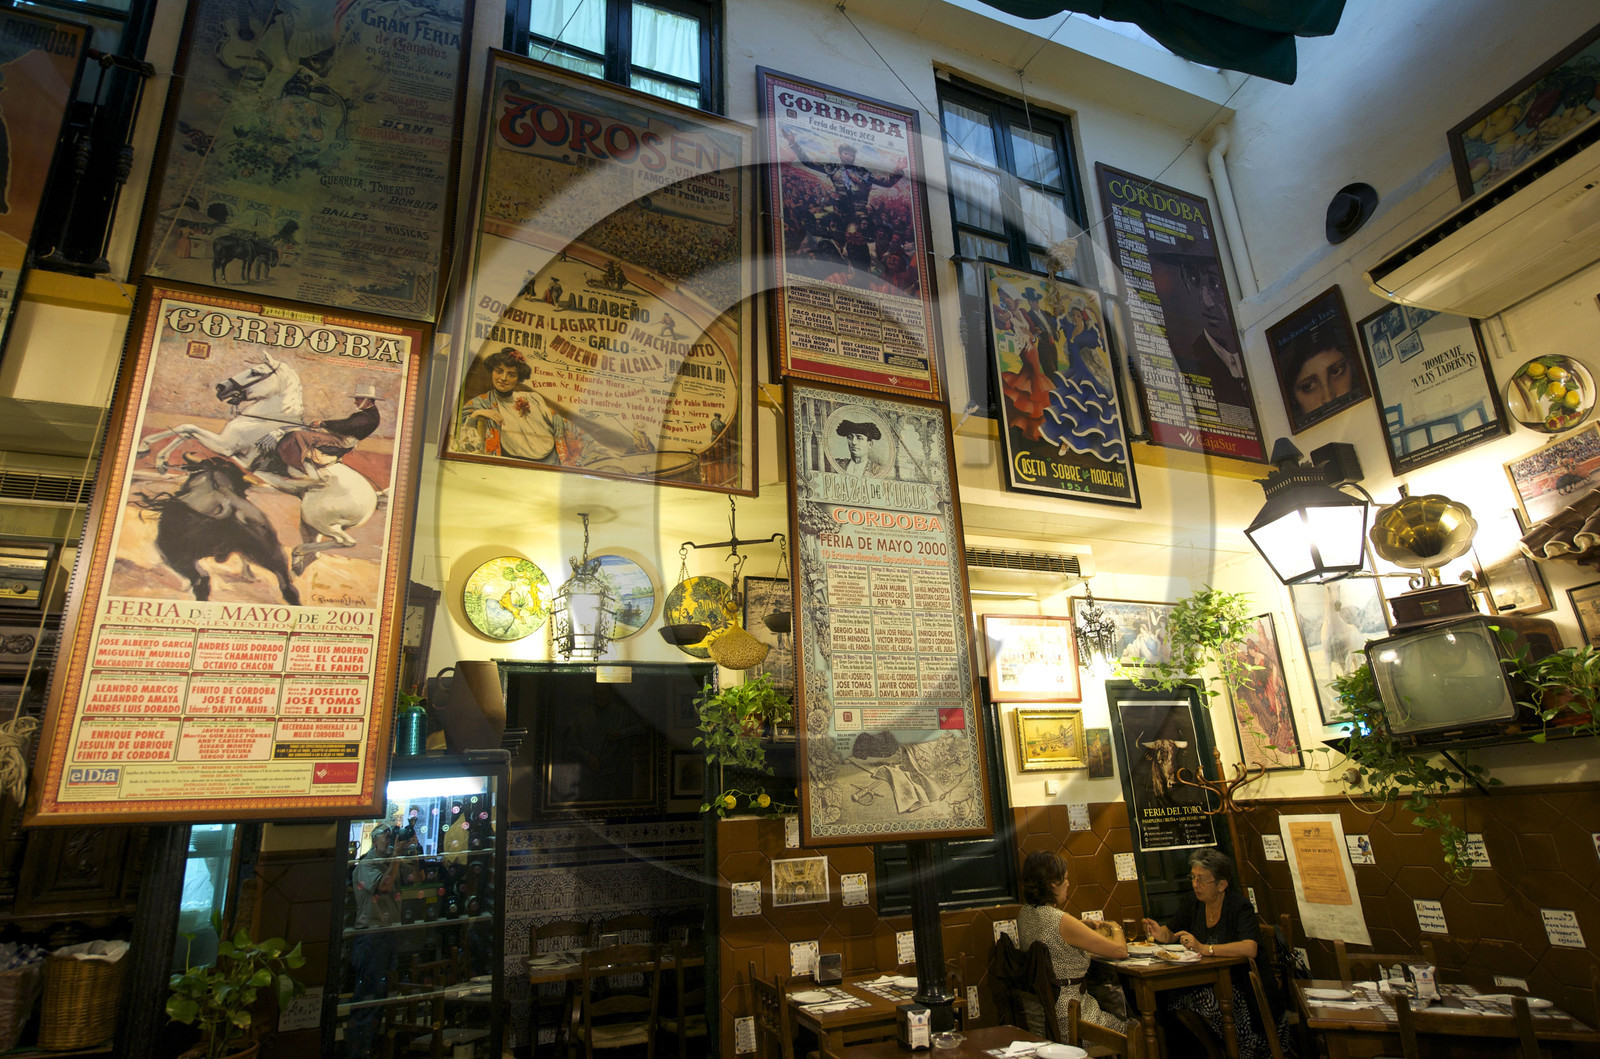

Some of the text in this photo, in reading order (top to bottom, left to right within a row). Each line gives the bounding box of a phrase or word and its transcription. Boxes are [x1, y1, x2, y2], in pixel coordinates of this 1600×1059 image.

[361, 8, 461, 51] GRAN FERIA
[778, 91, 905, 139] CORDOBA
[808, 116, 828, 130] Feria
[828, 122, 839, 131] de
[499, 94, 667, 174] TOROS
[670, 134, 721, 175] EN
[674, 166, 726, 190] VALENCIA
[369, 180, 416, 197] TORERITO
[638, 170, 731, 202] FAMOSAS CORRIDAS
[663, 187, 676, 196] DE
[388, 196, 439, 211] BOMBITA
[1108, 179, 1207, 225] CÓRDOBA
[320, 207, 369, 221] BAILES
[384, 225, 430, 240] MUSICAS
[568, 292, 650, 323] ALGABEÑO
[811, 311, 832, 320] OJEDA
[478, 294, 715, 358] BOMBITA LAGARTIJO MACHAQUITO
[165, 307, 403, 364] CORDOBA
[475, 322, 630, 354] REGATERIN GALLO
[791, 340, 836, 353] REYES MENDOZA
[549, 334, 663, 374] MORENO DE ALCALA
[1421, 344, 1466, 371] HOMENAJE
[668, 359, 713, 381] BOMBITA
[1411, 378, 1420, 389] A
[1418, 370, 1436, 386] LAS
[1434, 351, 1477, 377] TABERNAS
[575, 374, 626, 389] Eduardo Miura
[683, 398, 726, 409] Pablo Romero
[688, 410, 710, 419] Sierra
[685, 422, 707, 433] Varela
[1196, 434, 1237, 452] CajaSur
[1014, 451, 1047, 482] CASETA
[823, 474, 929, 511] PLAZA DE TOROS
[1061, 482, 1091, 493] 1954
[832, 507, 945, 533] CORDOBA
[820, 533, 947, 556] FERIA DE MAYO 2000
[105, 600, 374, 626] FERIA MAYO DE 2001
[233, 621, 295, 630] FESTEJOS
[854, 627, 869, 635] SANZ
[847, 635, 871, 643] MENDOZA
[918, 629, 938, 638] ENRIQUE
[99, 638, 120, 646] JOSE
[122, 639, 160, 648] ALBERTO
[231, 643, 284, 652] LUIS DORADO
[149, 650, 190, 659] MURILLO
[290, 645, 369, 655] JOSE LUIS MORENO
[224, 652, 278, 661] CHAMANIETO
[316, 655, 364, 664] EL CALIFA
[95, 659, 154, 668] MACHAQUITO DE
[202, 661, 239, 669] OCTAVIO
[314, 664, 364, 672] EL FANDI
[96, 684, 178, 694] LEANDRO MARCOS
[191, 686, 234, 694] FINITO DE
[836, 681, 850, 689] JOSE
[879, 682, 918, 690] JAVIER CONDE
[308, 688, 360, 696] JOSELITO
[91, 694, 179, 704] ALEJANDRO AMAYA
[201, 696, 227, 704] JOSE
[285, 697, 315, 705] JOSE
[123, 704, 181, 713] LUIS DORADO
[304, 706, 355, 714] EL JULI
[91, 730, 165, 740] ENRIQUE PONCE
[118, 740, 131, 749] DE
[132, 740, 174, 749] UBRIQUE
[76, 751, 124, 760] FINITO DE
[1143, 805, 1202, 817] FERIA DEL TORO
